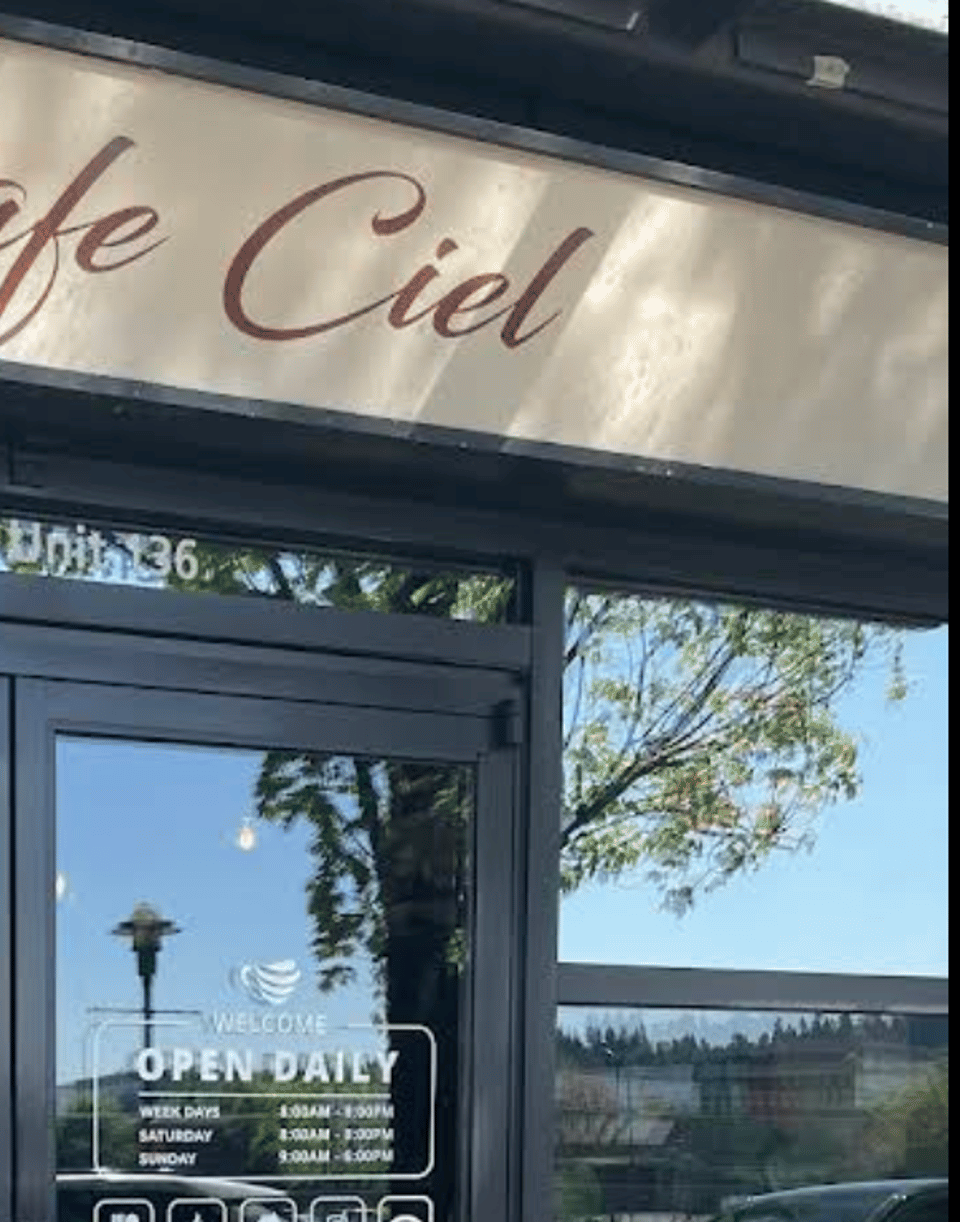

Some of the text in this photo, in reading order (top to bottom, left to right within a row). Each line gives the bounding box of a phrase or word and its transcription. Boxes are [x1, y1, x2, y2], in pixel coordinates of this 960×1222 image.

[221, 170, 596, 349] Ciel
[213, 1011, 328, 1036] WELCOME
[137, 1049, 400, 1084] OPEN DAILY
[139, 1105, 182, 1119] WEEK
[184, 1106, 221, 1119] DAYS
[139, 1129, 214, 1144] SATURDAY
[138, 1152, 198, 1166] SUNDAY
